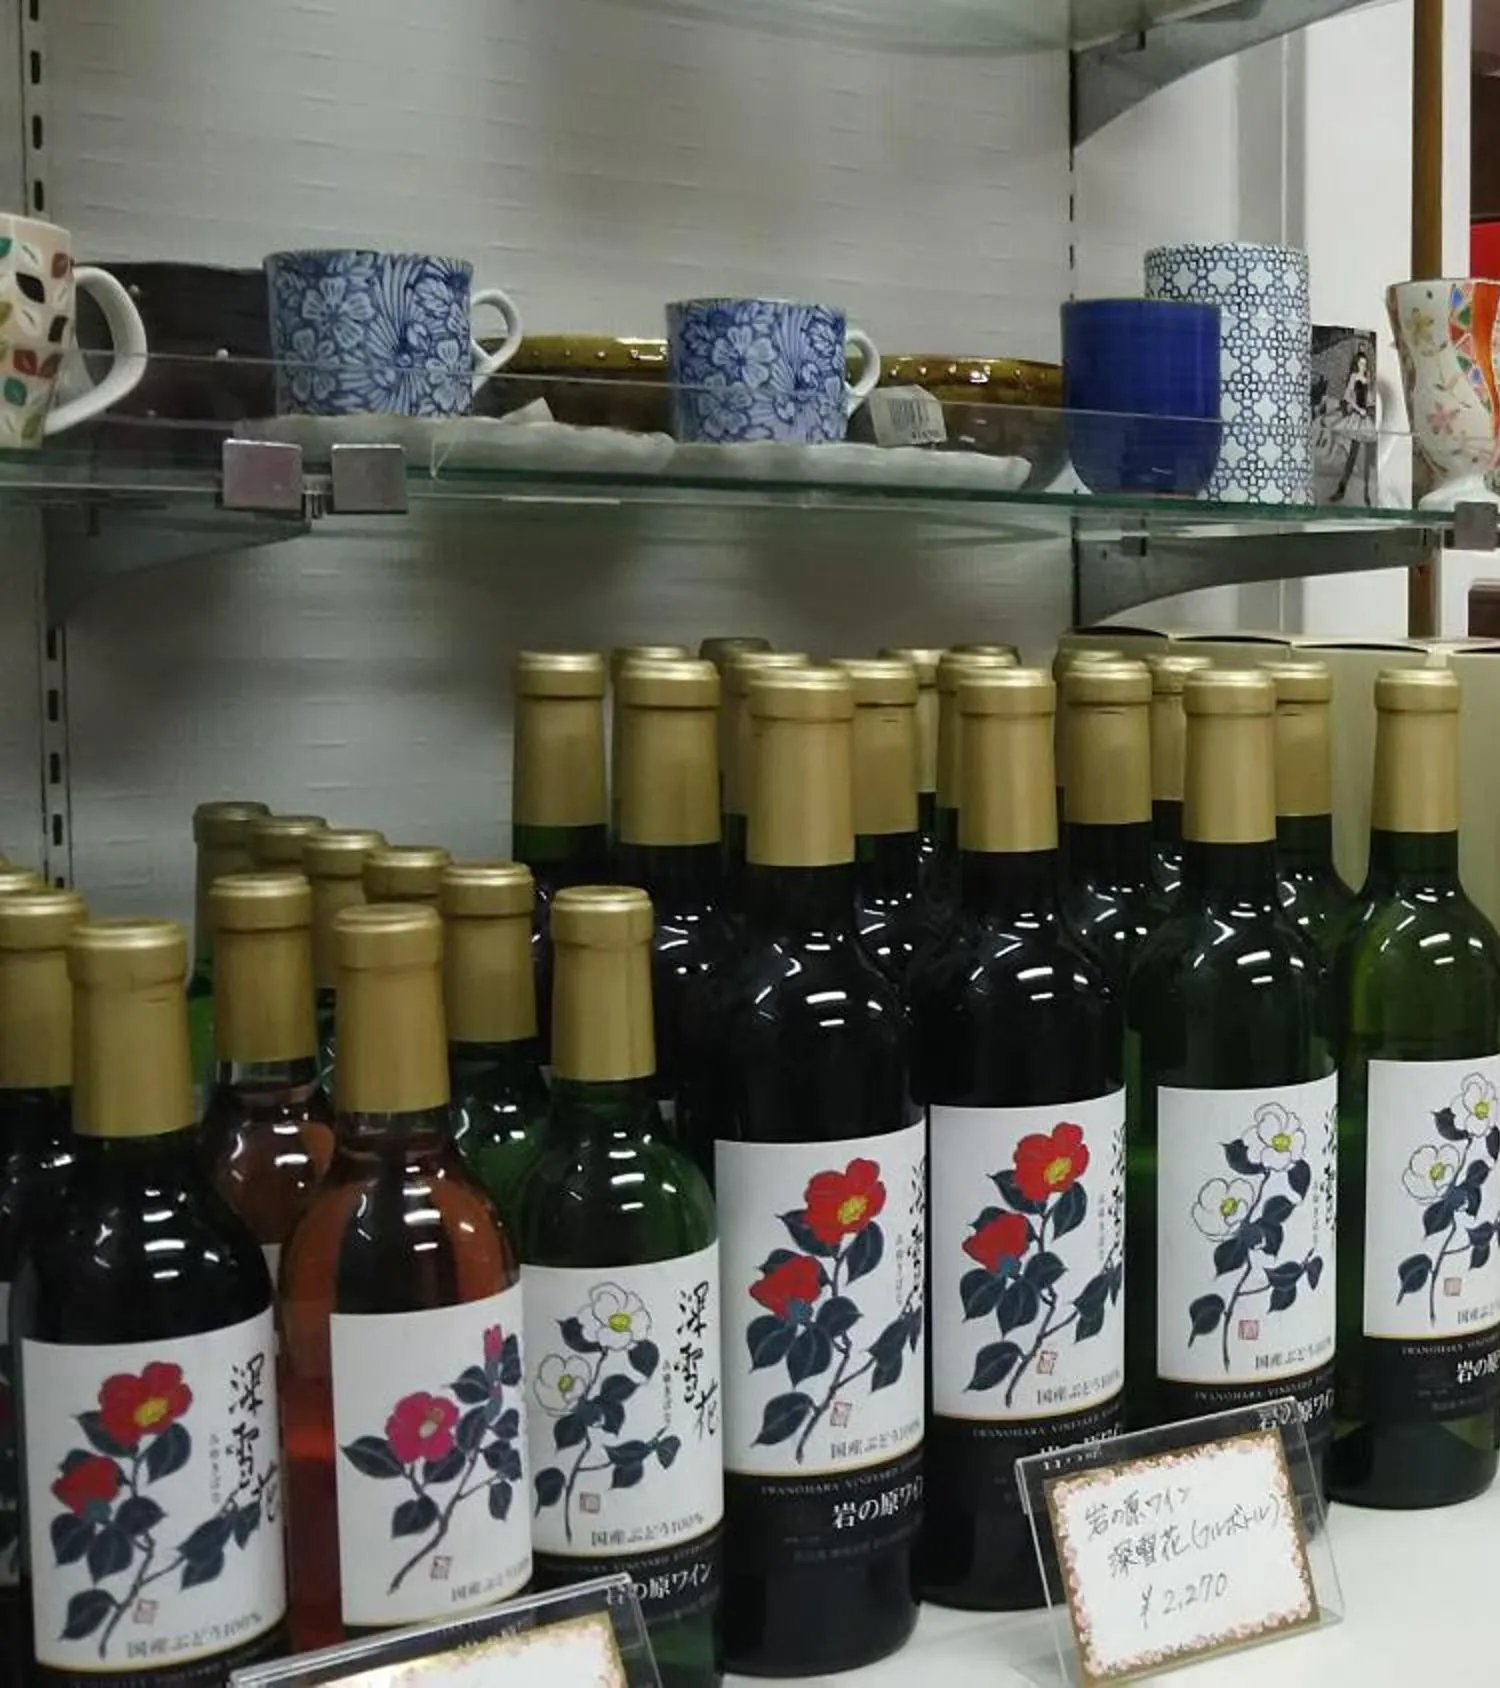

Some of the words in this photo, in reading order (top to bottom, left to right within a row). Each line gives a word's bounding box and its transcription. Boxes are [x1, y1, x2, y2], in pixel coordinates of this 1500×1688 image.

[1084, 1485, 1193, 1540] 岩の原ワイン
